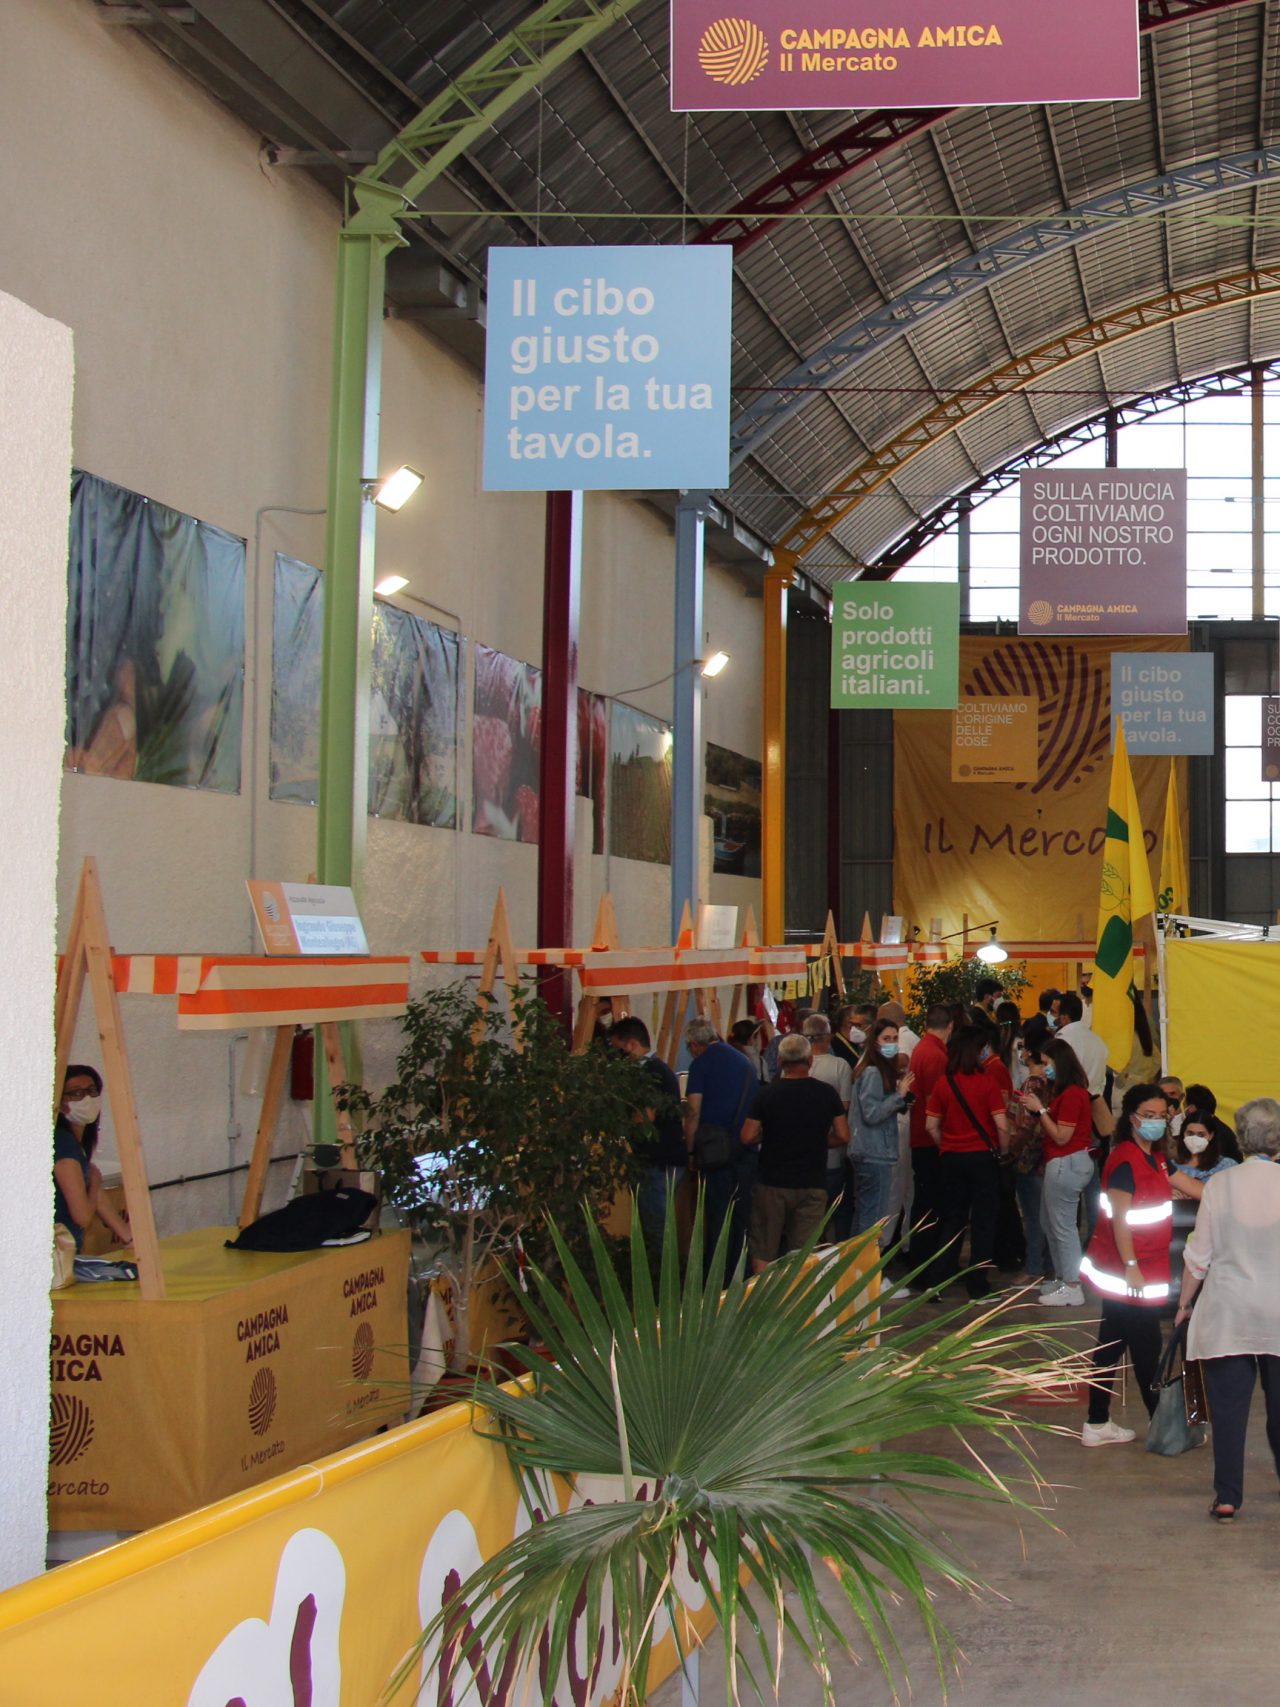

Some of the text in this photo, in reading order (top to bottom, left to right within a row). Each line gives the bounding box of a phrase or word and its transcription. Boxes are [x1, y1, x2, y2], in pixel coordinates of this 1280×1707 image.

[780, 25, 1003, 50] CAMPAGNA AMICA
[780, 52, 898, 72] Il Mercato
[512, 278, 655, 317] Il cibo
[510, 326, 660, 375] giusto
[510, 376, 713, 420] per la tua
[507, 423, 653, 460] tavola.
[1033, 482, 1175, 501] SULLA FIDUCIA
[1032, 504, 1165, 522] COLTIVIAMO
[1032, 525, 1174, 544] OGNI NOSTRO
[1032, 547, 1147, 565] PRODOTTO.
[842, 601, 895, 620] Solo
[1057, 604, 1138, 614] CAMPAGNA AMICA
[842, 626, 932, 649] prodotti
[841, 650, 935, 675] agricoli
[841, 674, 931, 695] italiani.
[1121, 666, 1182, 682] Il cibo
[1121, 686, 1184, 706] giusto
[957, 703, 1028, 713] COLTIVIAMO
[1121, 707, 1207, 722] per la tua
[956, 725, 992, 735] DELLE
[1126, 727, 1182, 742] avola.
[343, 1266, 385, 1299] CAMPAGNA
[351, 1290, 378, 1317] AMICA
[237, 1304, 289, 1342] CAMPAGNA
[50, 1334, 126, 1356] PAGNA
[246, 1331, 281, 1363] AMICA
[50, 1359, 102, 1381] ICA
[250, 1440, 286, 1465] Mercato
[48, 1479, 110, 1496] ercato
